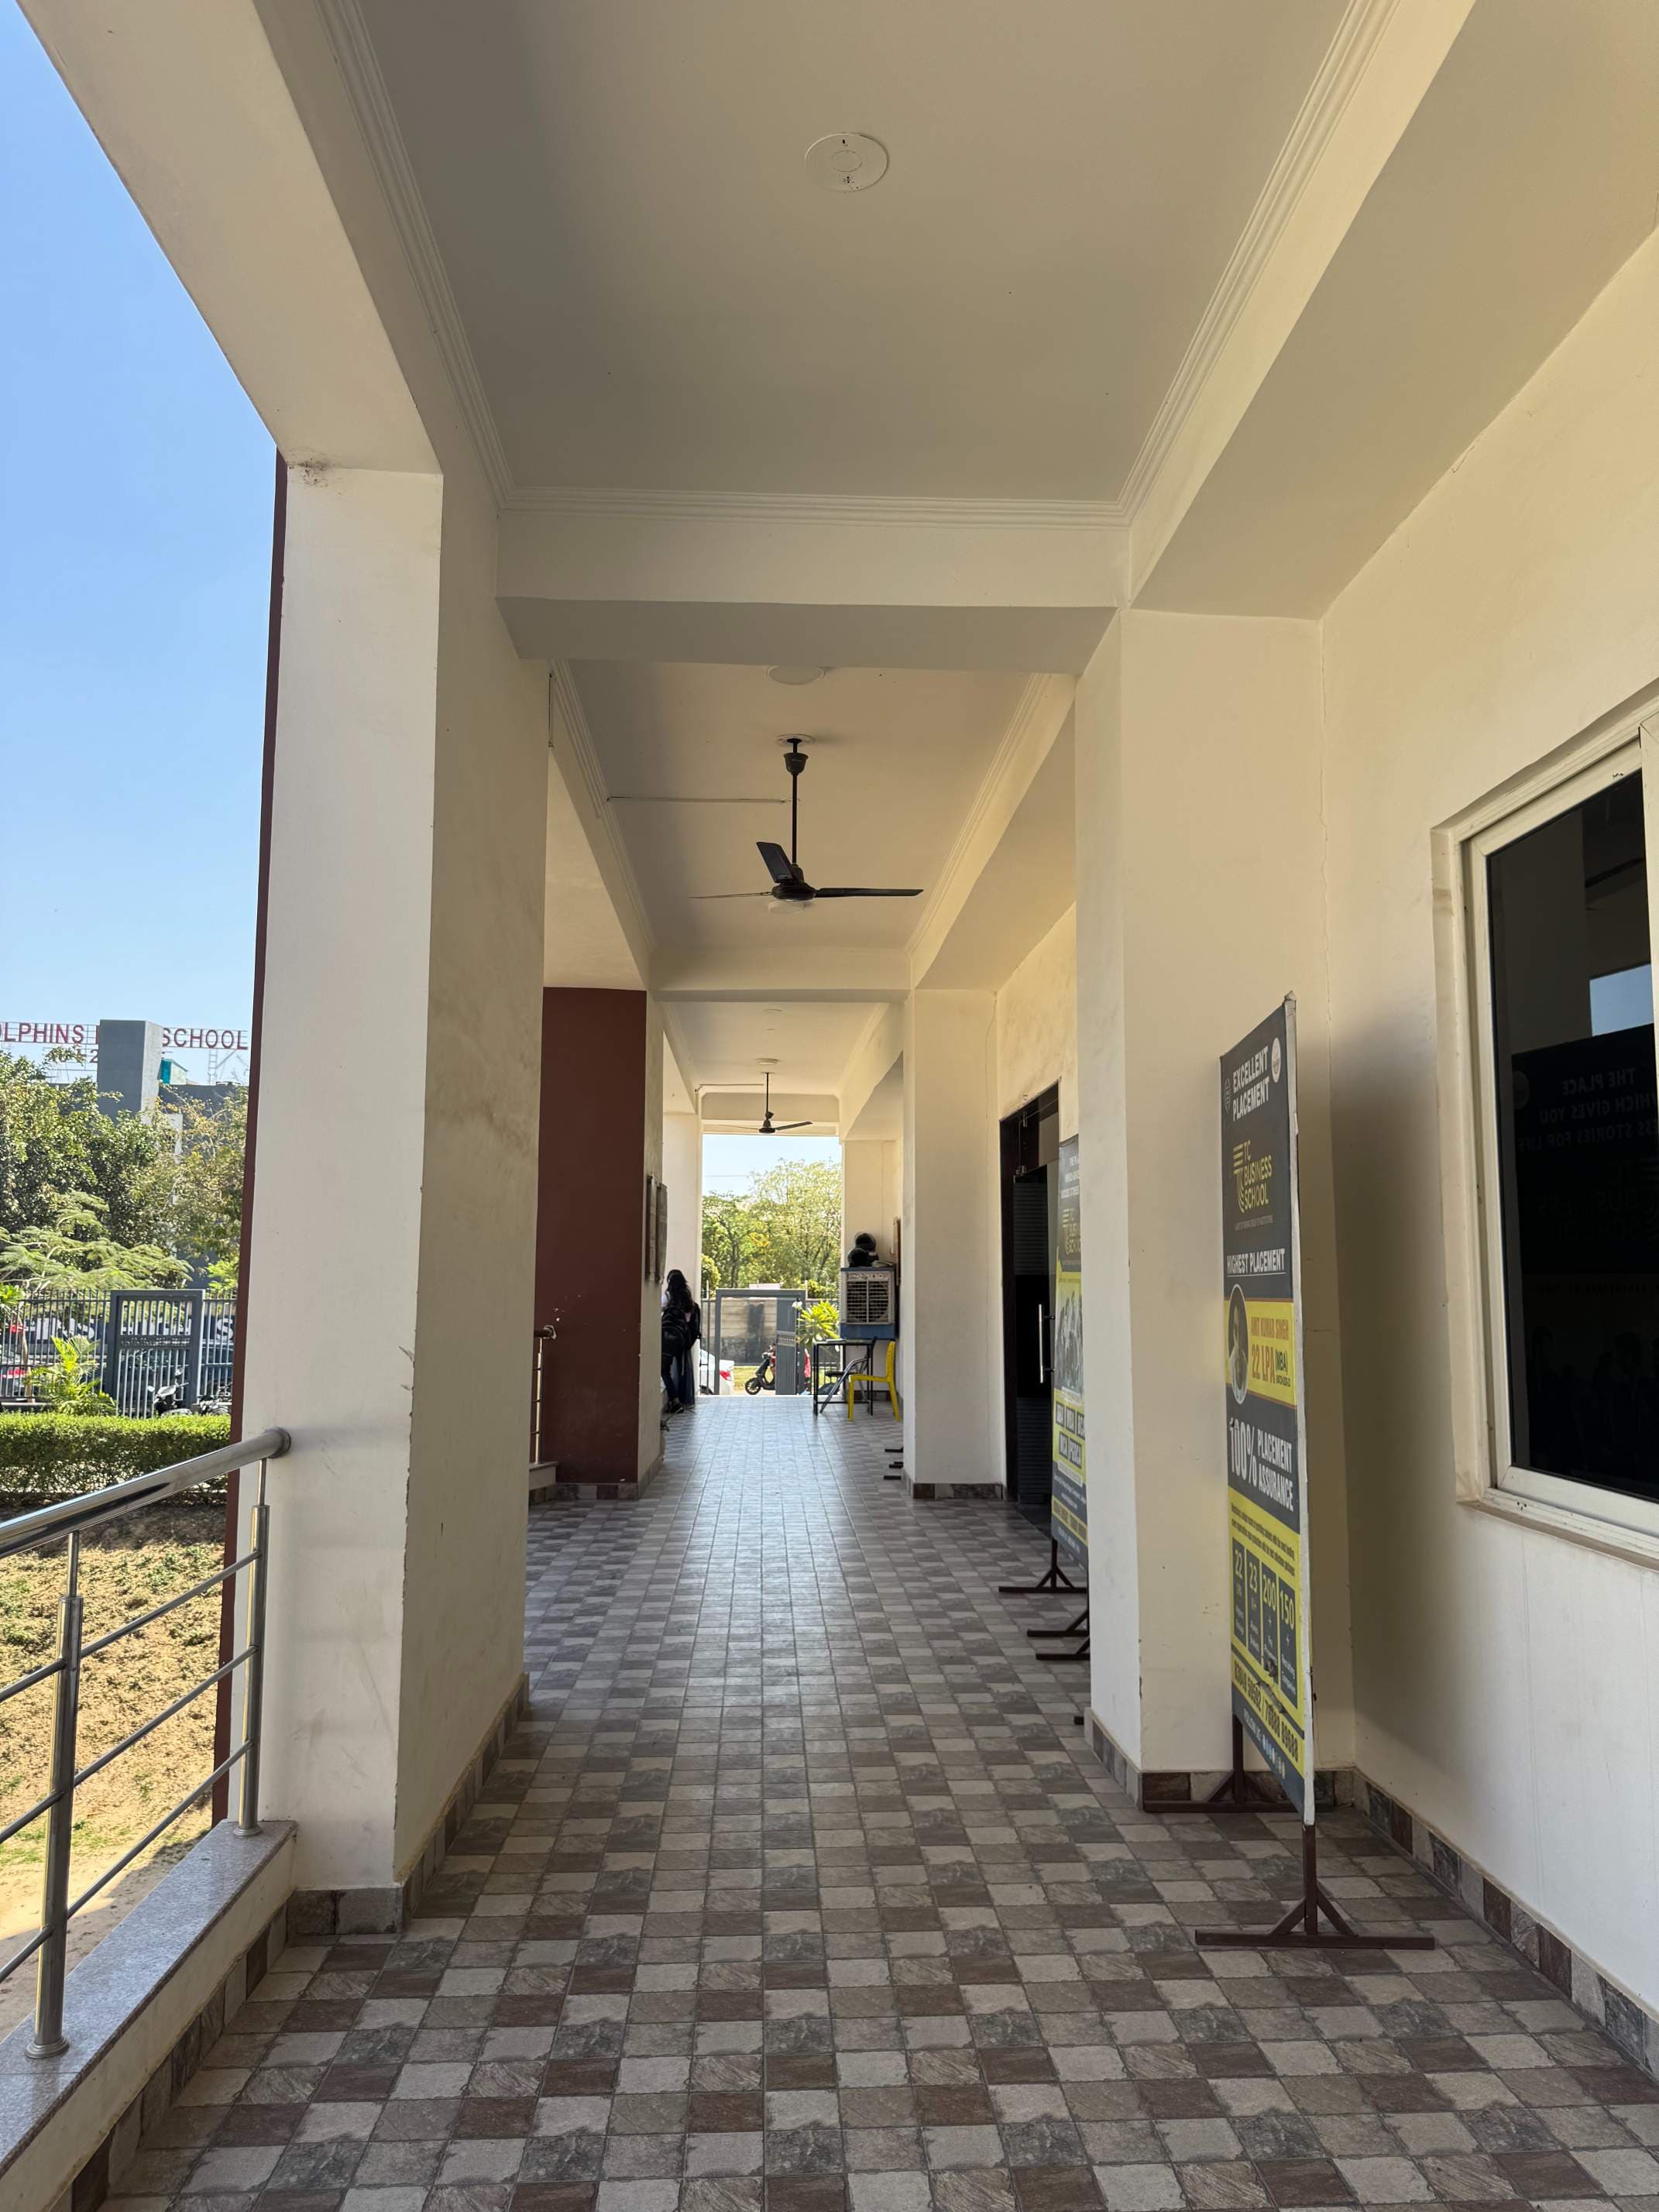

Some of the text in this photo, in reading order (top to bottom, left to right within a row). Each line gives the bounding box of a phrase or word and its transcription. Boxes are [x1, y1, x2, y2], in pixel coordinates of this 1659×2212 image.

[0, 1022, 84, 1044] LPHINS
[163, 1028, 248, 1049] SCHOOL
[1233, 1046, 1269, 1094] EXCELLENT
[1233, 1076, 1269, 1121] PLACEMENT
[1244, 1154, 1273, 1186] BUSINESS
[1244, 1183, 1269, 1210] SCHOOL
[1227, 1248, 1286, 1275] HIGHEST PLACEMENT
[1252, 1344, 1260, 1379] 22
[1262, 1345, 1276, 1384] LPA
[1229, 1417, 1257, 1487] 100%
[1257, 1428, 1292, 1474] PLACEMENT
[1259, 1463, 1293, 1511] ASSURANCE
[1235, 1549, 1243, 1579] 22
[1249, 1561, 1258, 1593] 23
[1263, 1574, 1276, 1611] 200
[1280, 1590, 1295, 1630] 150
